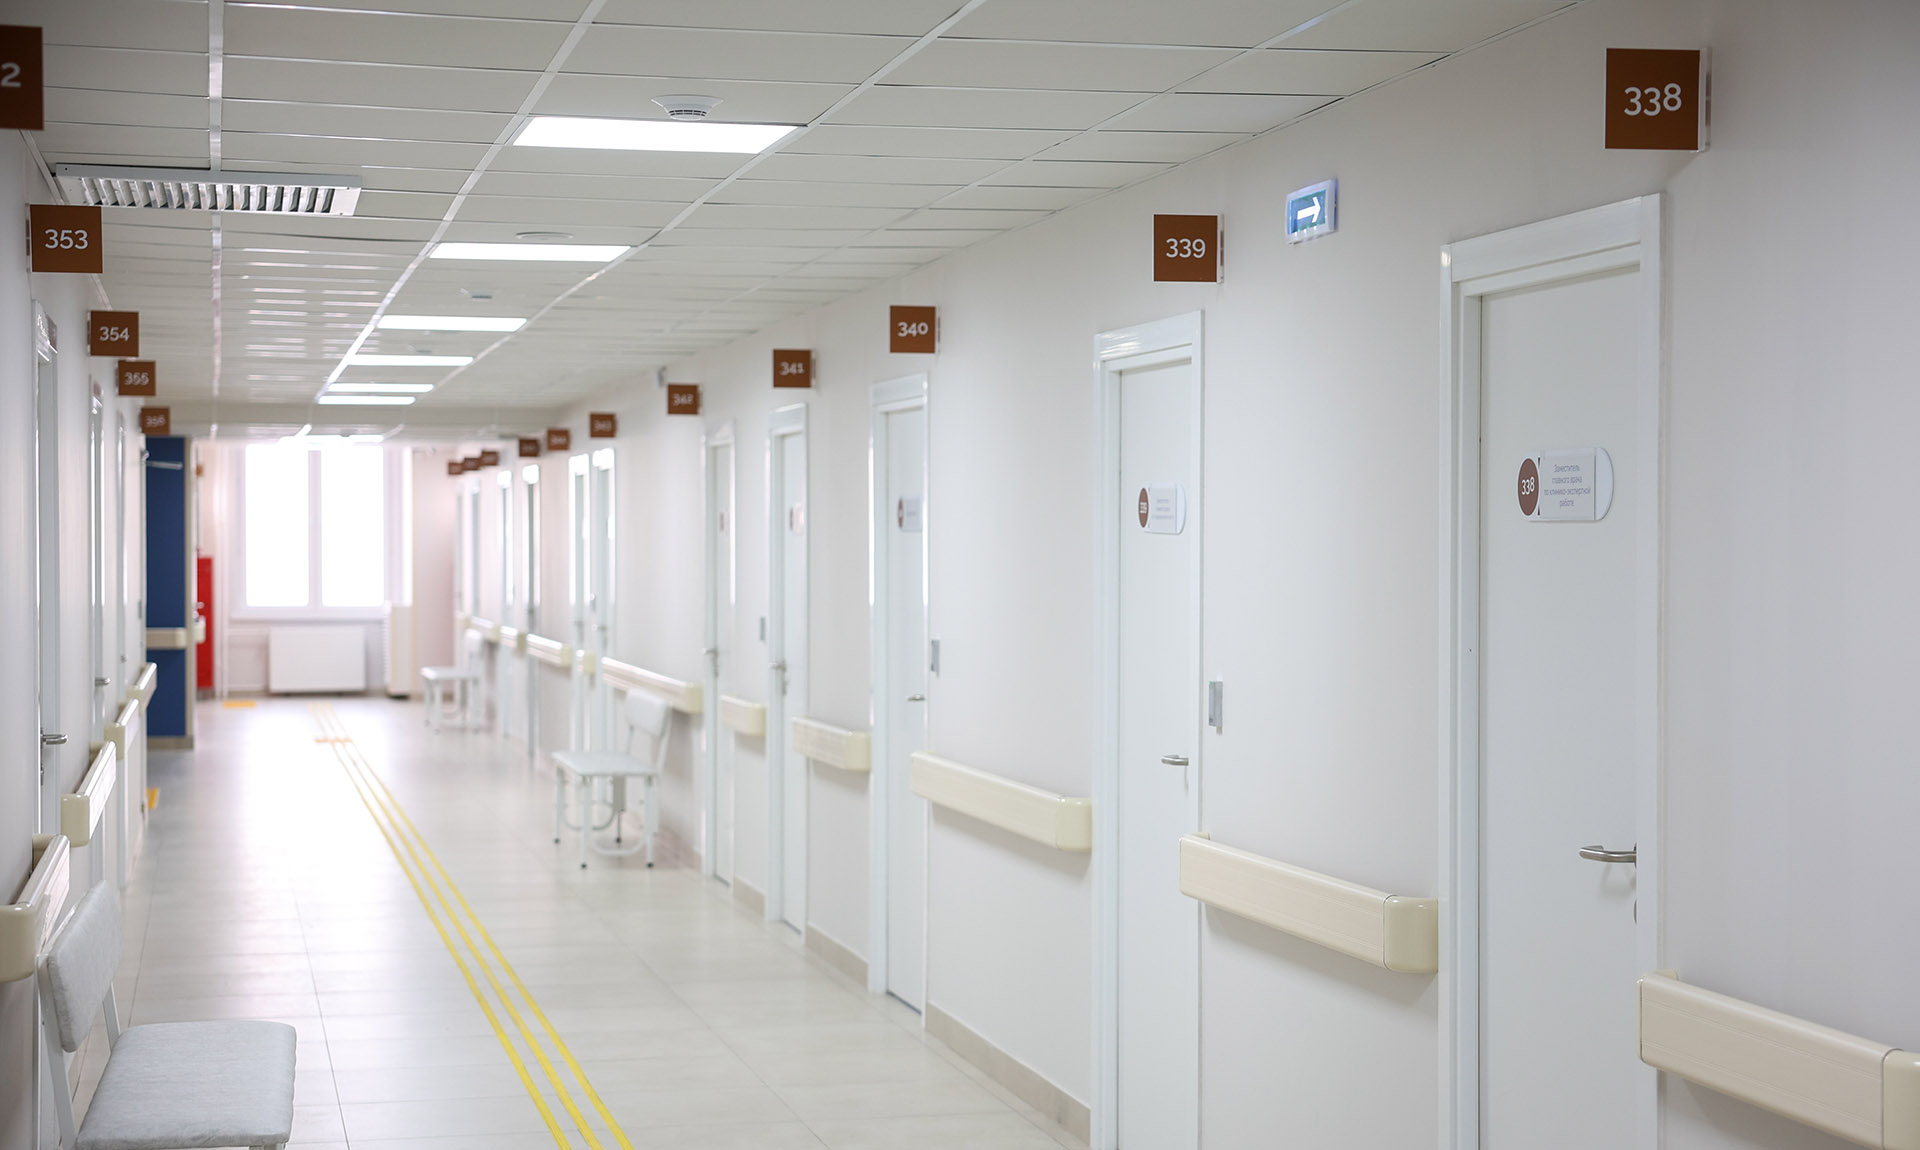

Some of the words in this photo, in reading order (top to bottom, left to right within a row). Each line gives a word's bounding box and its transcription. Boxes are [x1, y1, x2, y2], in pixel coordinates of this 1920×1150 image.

[1623, 82, 1682, 117] 338
[44, 228, 89, 250] 353
[1165, 238, 1206, 259] 339
[99, 325, 130, 343] 354
[897, 320, 929, 338] 340
[779, 361, 805, 376] 341
[1521, 476, 1535, 495] 338
